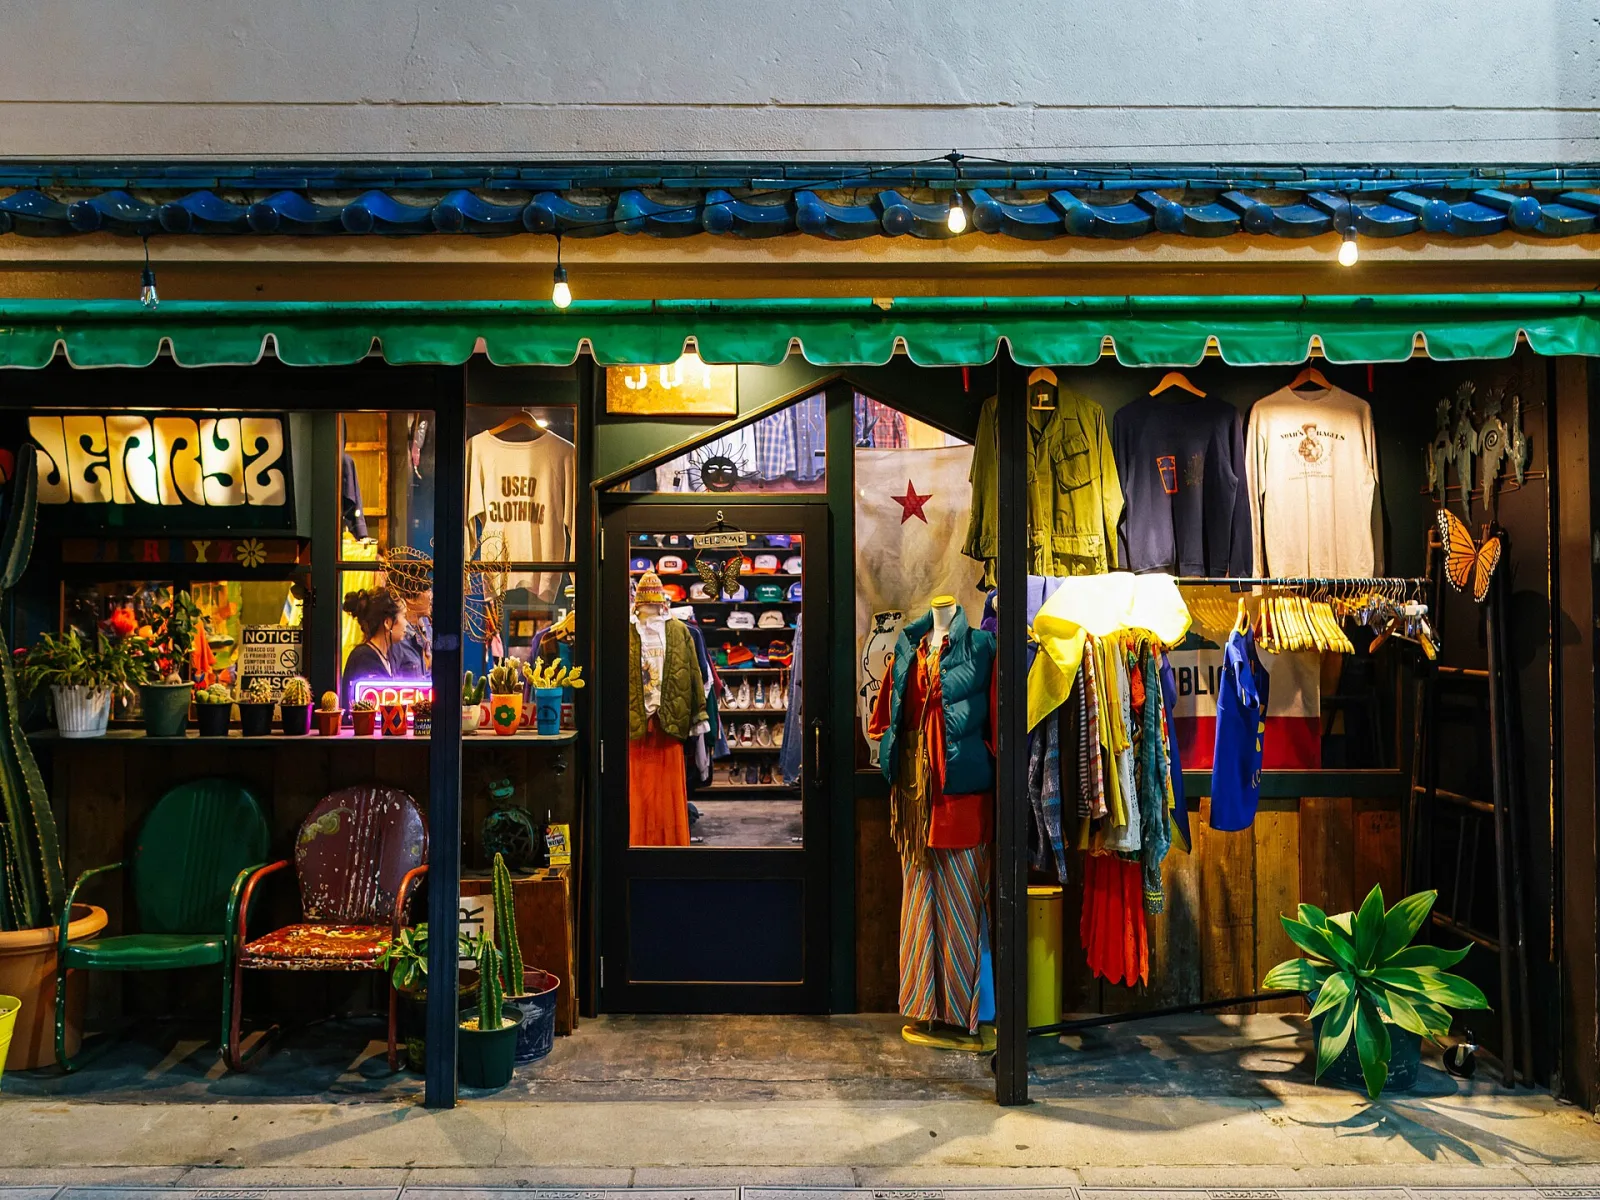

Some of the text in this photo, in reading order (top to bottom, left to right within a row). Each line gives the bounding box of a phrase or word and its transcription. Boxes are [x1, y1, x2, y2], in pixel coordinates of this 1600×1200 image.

[1316, 430, 1345, 440] BAGELS
[28, 415, 286, 506] JERRYZ
[501, 476, 537, 497] USED
[489, 501, 545, 525] CLOTHING
[695, 534, 745, 546] WELCOME
[245, 631, 300, 643] NOTICE
[248, 677, 291, 689] AISO
[1174, 665, 1225, 696] BLI
[361, 688, 432, 716] OPEN
[519, 705, 573, 726] SAE
